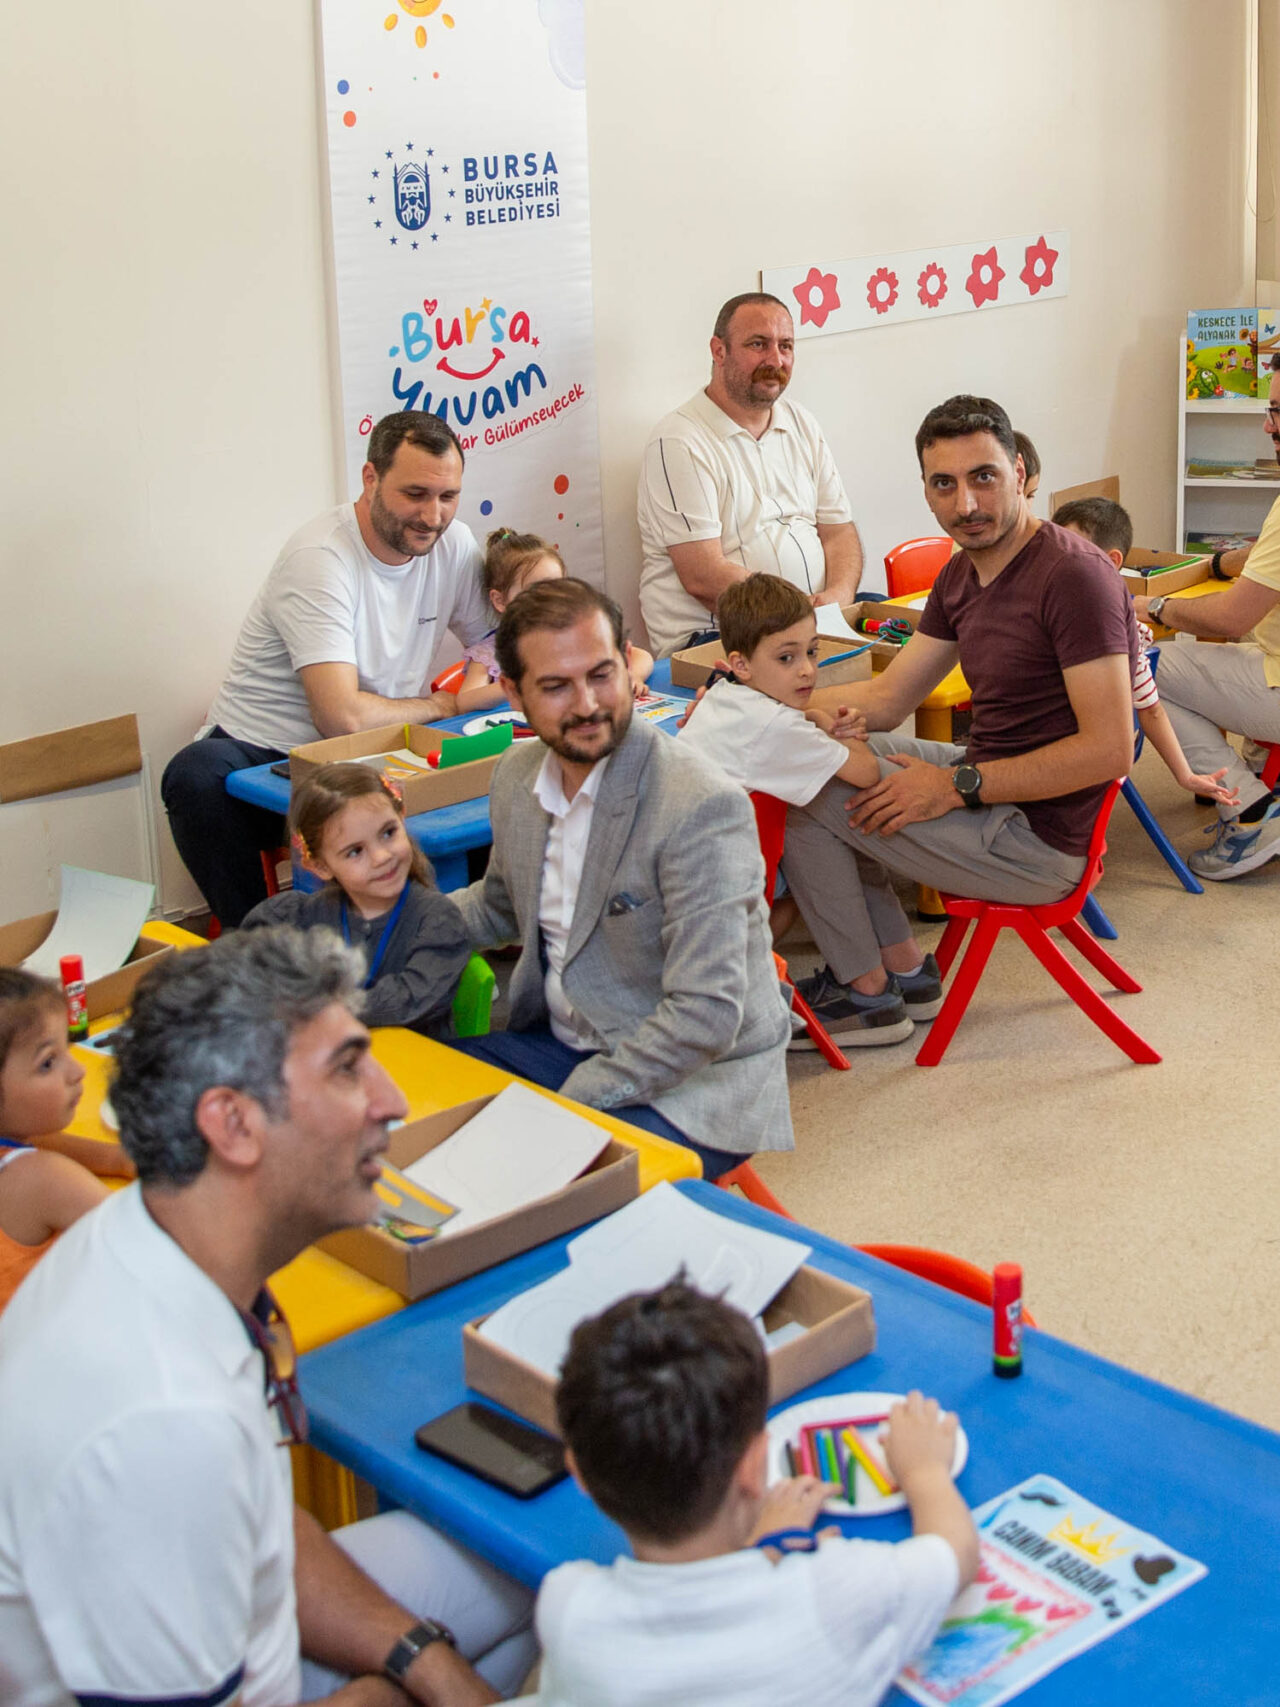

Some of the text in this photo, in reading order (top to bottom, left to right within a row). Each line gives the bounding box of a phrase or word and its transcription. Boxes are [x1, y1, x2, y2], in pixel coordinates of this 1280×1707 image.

[463, 151, 559, 182] BURSA
[464, 177, 559, 204] BÜYÜKŞEHİR
[465, 198, 561, 226] BELEDİYESİ
[402, 306, 530, 363] Bursa
[1198, 316, 1236, 328] KESMECE
[1198, 330, 1236, 341] ALYANAK
[392, 362, 547, 426] Yuvam
[484, 383, 585, 446] Gülümseyecek
[992, 1520, 1117, 1596] CANIM BABAM
